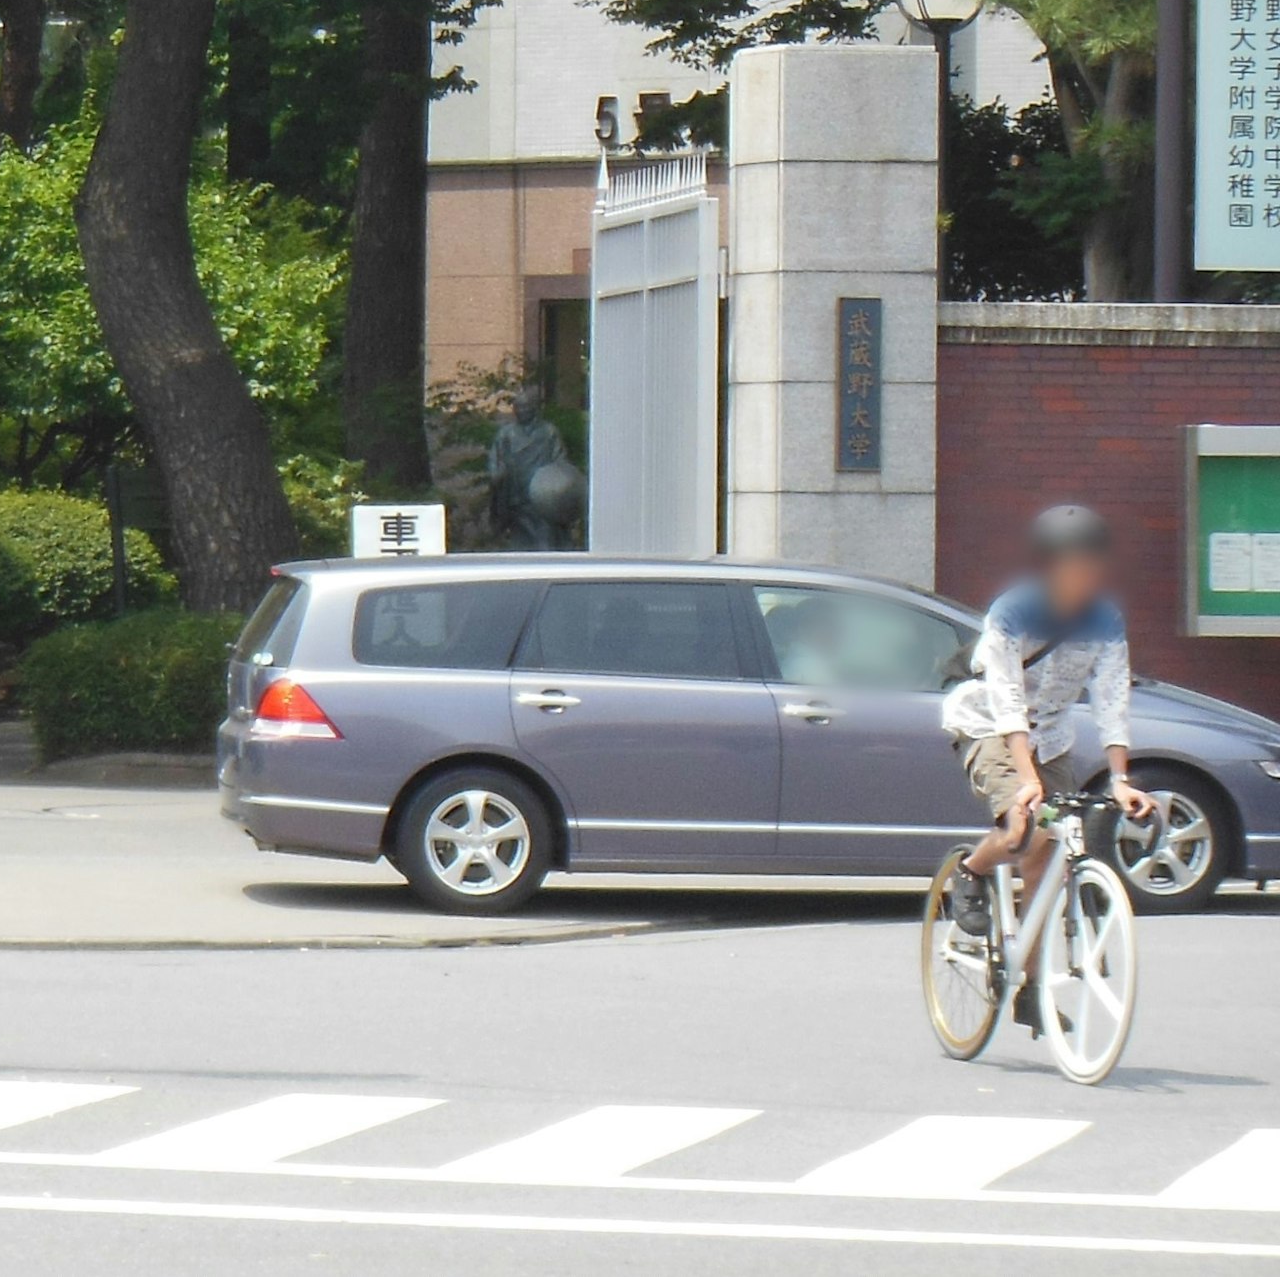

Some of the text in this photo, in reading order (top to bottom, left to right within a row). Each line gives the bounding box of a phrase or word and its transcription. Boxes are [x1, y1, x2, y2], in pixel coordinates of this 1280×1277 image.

[847, 308, 873, 460] 武蔵野大学
[380, 512, 419, 555] 車
